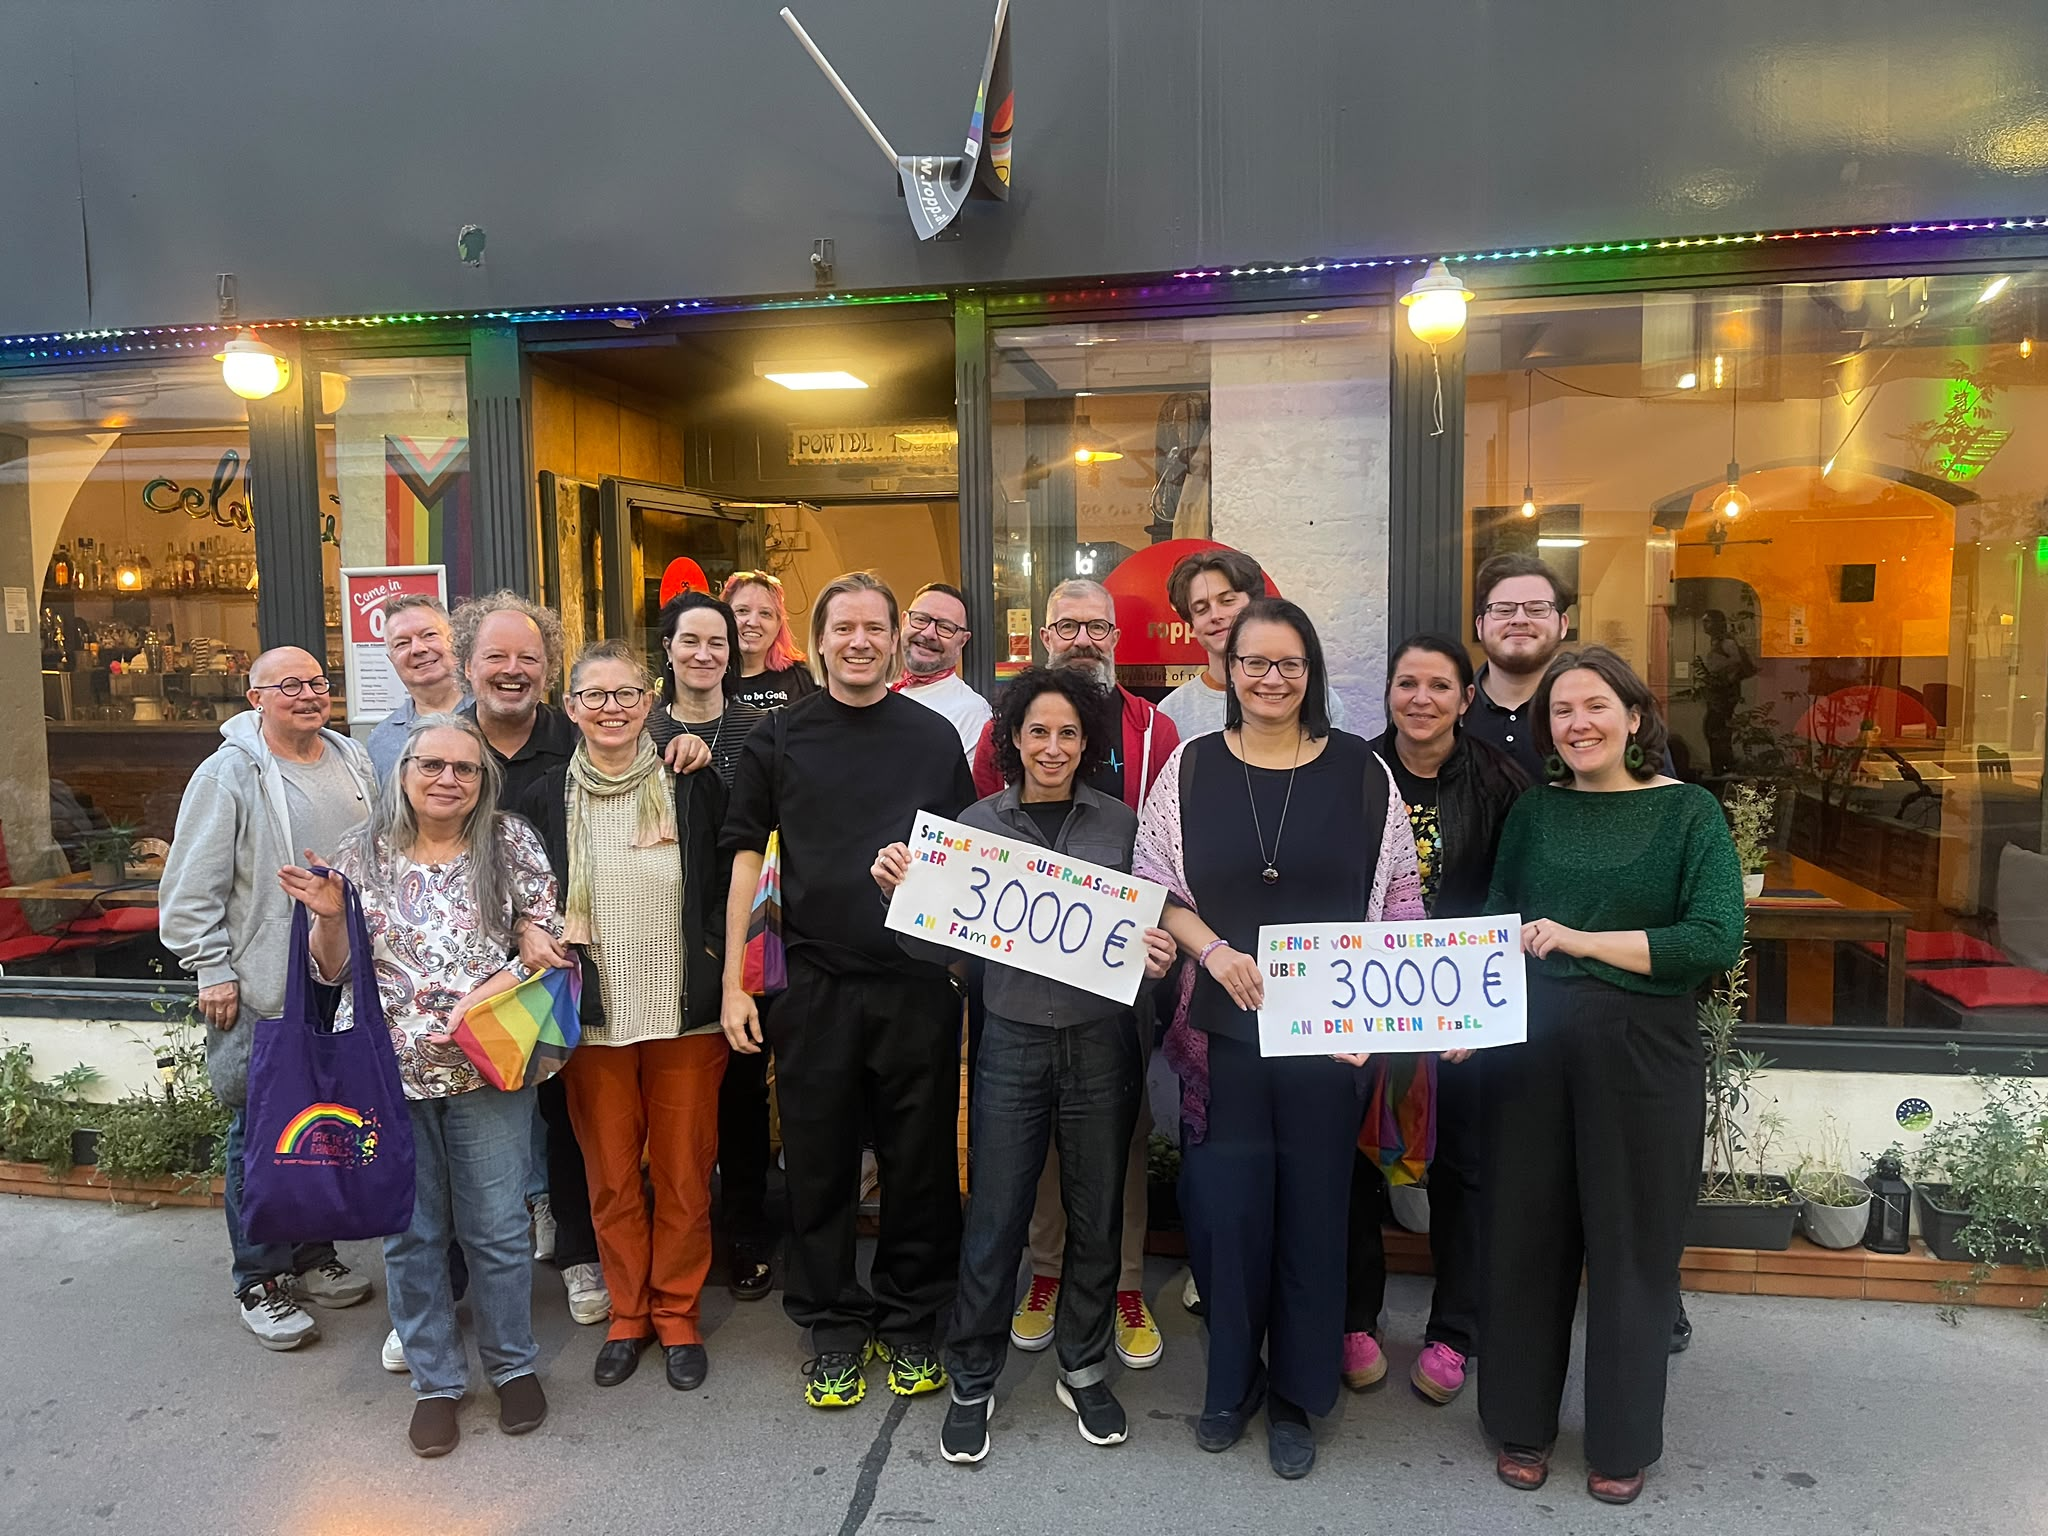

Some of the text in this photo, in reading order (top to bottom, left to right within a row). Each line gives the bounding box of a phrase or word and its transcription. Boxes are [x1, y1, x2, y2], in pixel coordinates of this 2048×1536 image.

[353, 579, 402, 607] Come in
[1172, 670, 1184, 681] of
[753, 691, 764, 701] be
[765, 690, 788, 701] Goth
[920, 824, 973, 853] SPENDE
[980, 846, 1010, 863] VON
[914, 912, 936, 930] AN
[953, 866, 1093, 954] 3000
[1102, 918, 1136, 968] €
[1269, 928, 1509, 951] SPENDE VON QUEERMASCHEN
[1269, 951, 1508, 1008] ÜBER 3000 €
[1290, 1014, 1483, 1035] AN DEN VEREIN FIBEL
